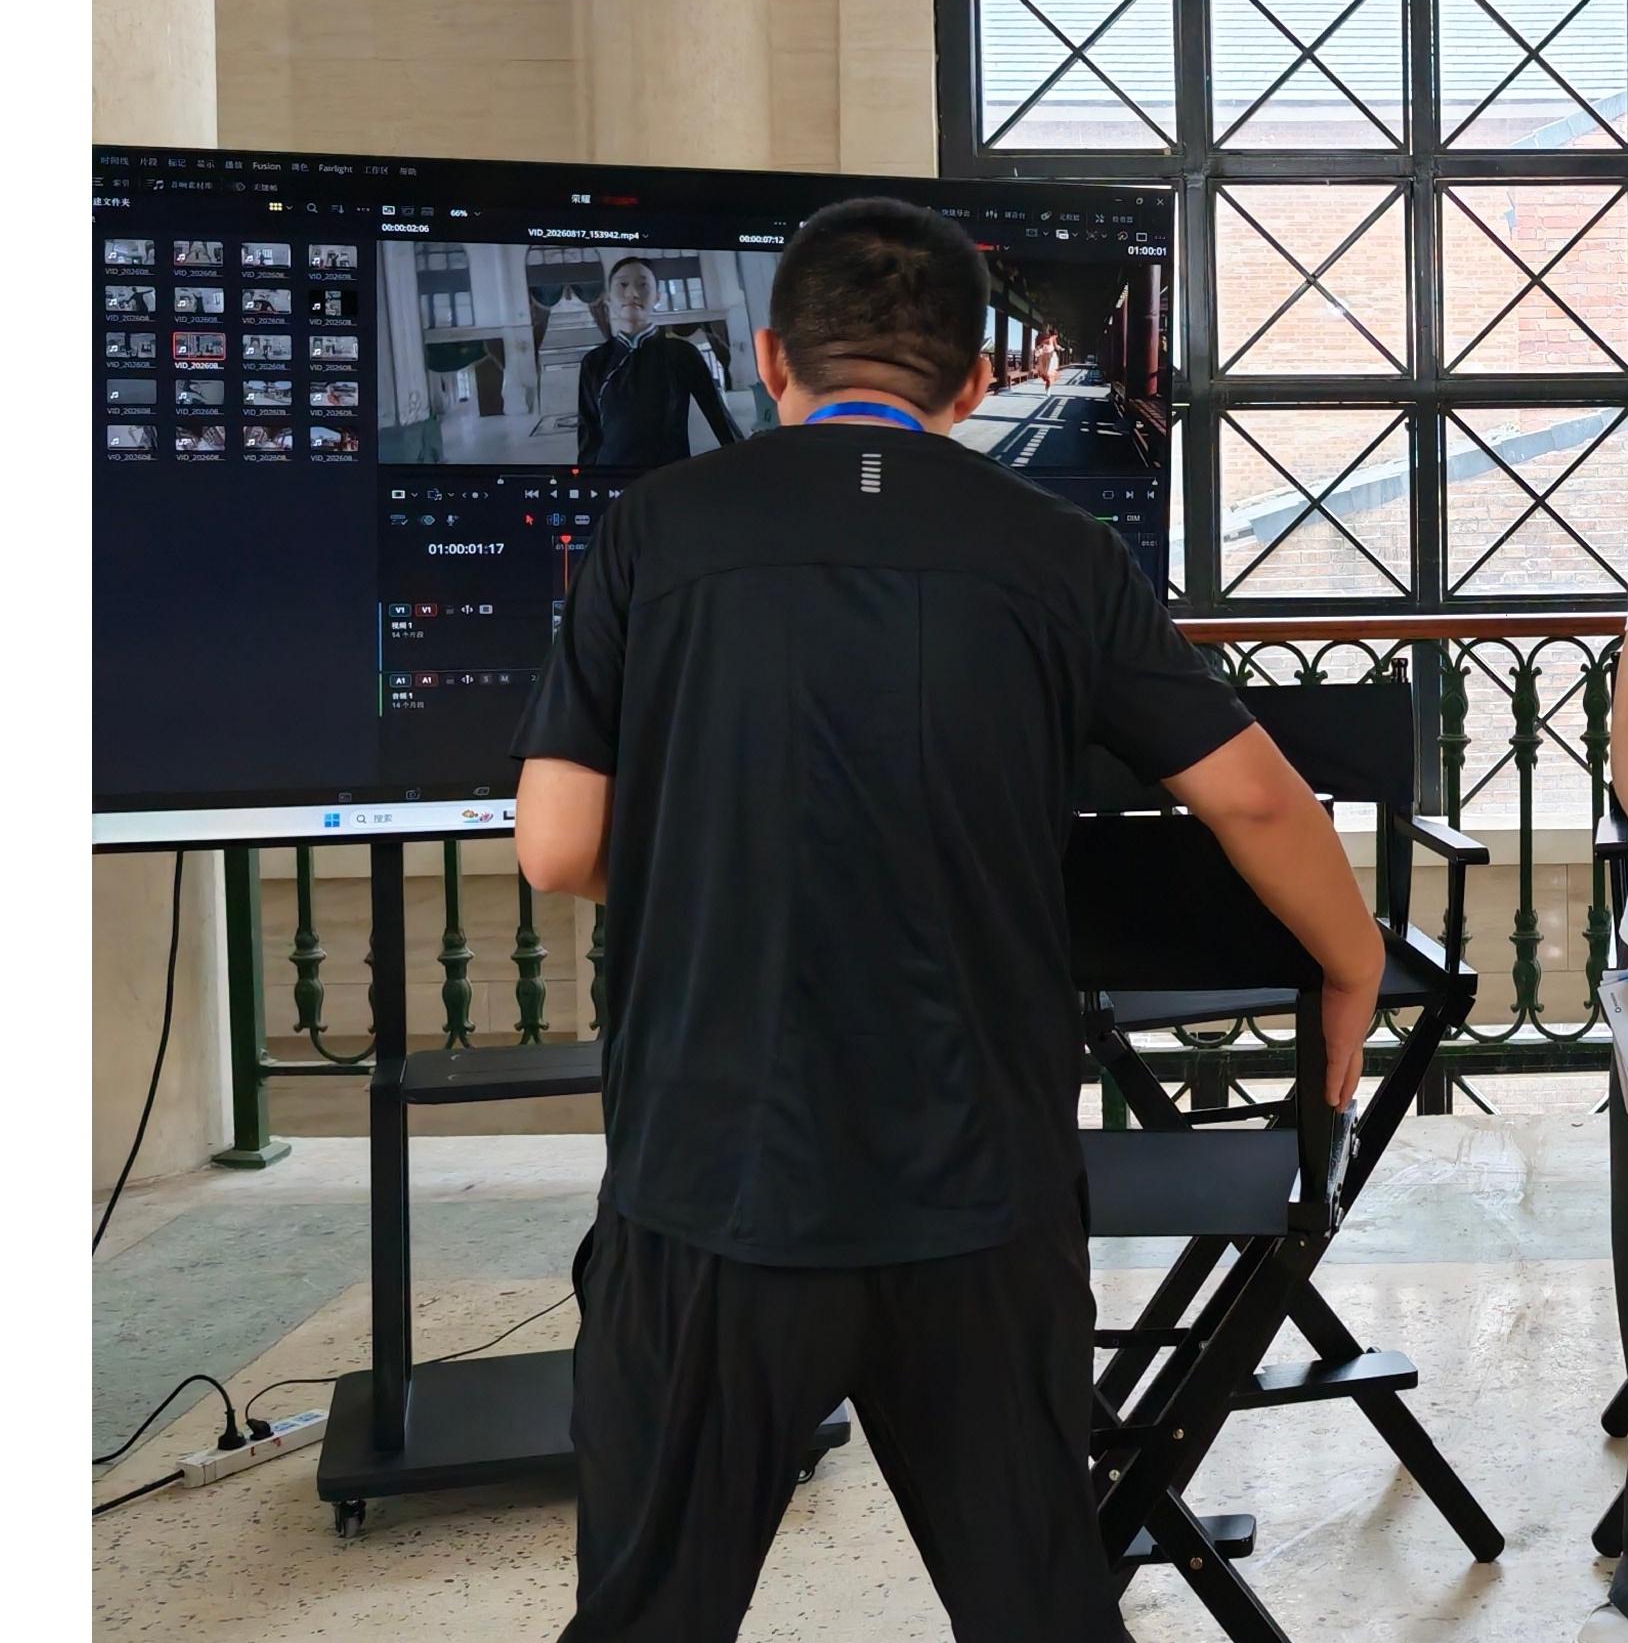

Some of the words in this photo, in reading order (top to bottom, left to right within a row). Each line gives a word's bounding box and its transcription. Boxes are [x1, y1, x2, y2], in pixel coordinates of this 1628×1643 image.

[252, 161, 282, 171] Fusion
[318, 163, 354, 175] Fairlight
[450, 209, 469, 218] 66%
[381, 222, 430, 234] 00:00:02:06
[738, 233, 785, 245] 00:00:07:12
[1127, 245, 1168, 257] 01:00:01
[428, 542, 505, 555] 01:00:01:17
[395, 606, 406, 614] V1
[421, 606, 432, 614] V1
[422, 676, 432, 684] A1
